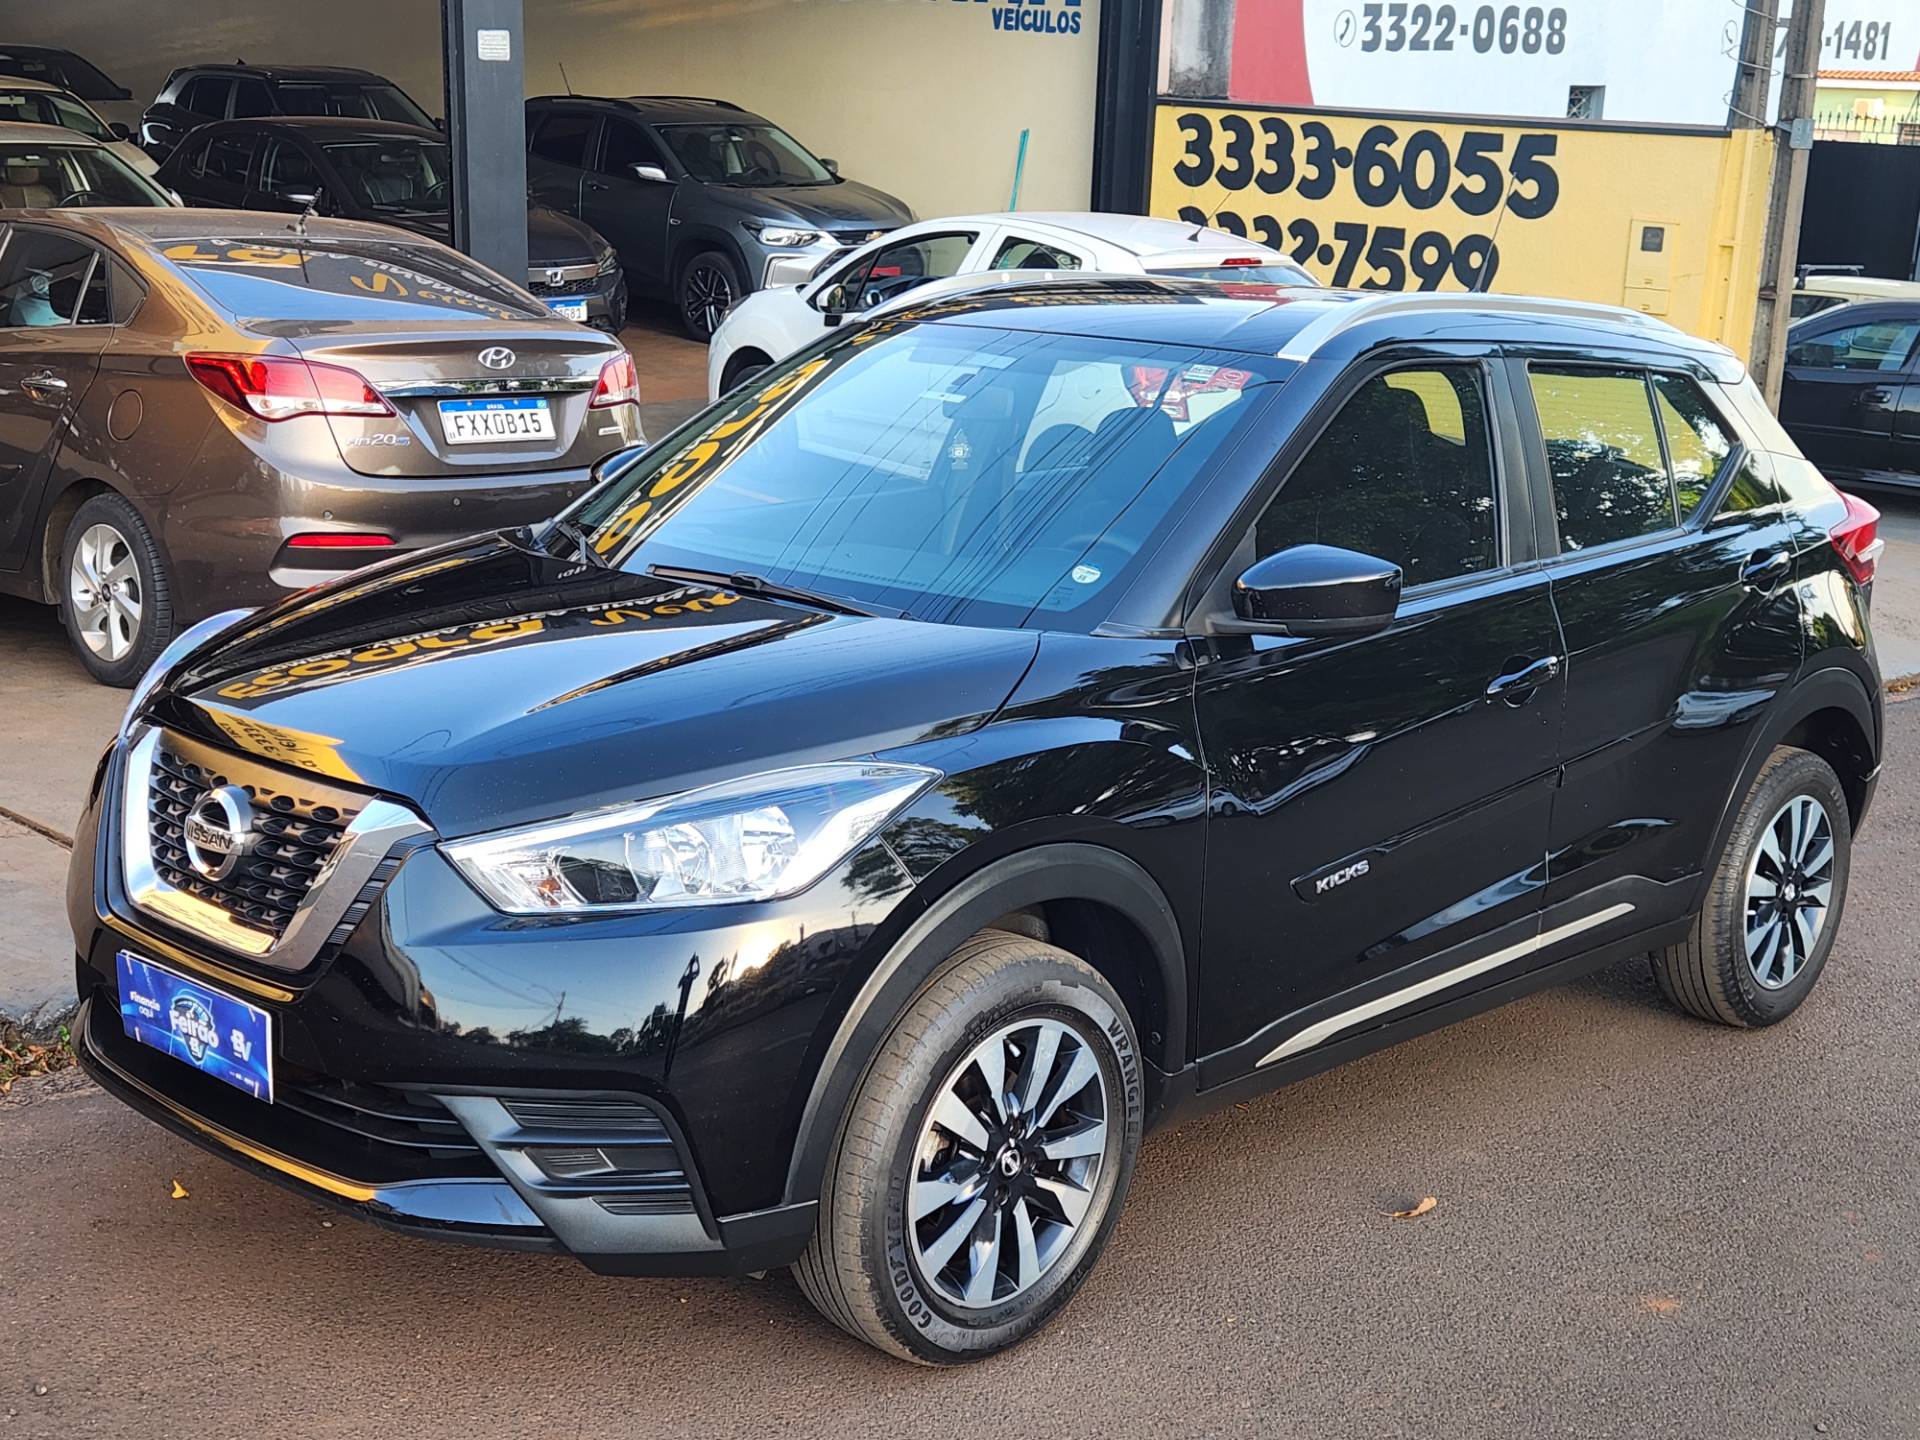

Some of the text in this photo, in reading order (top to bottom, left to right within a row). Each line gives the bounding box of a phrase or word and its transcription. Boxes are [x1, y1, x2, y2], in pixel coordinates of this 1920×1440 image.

[991, 5, 1082, 34] VEÍCULOS
[454, 412, 542, 437] FXX0B15
[186, 821, 233, 850] NISSAN
[1315, 859, 1370, 894] KICKS
